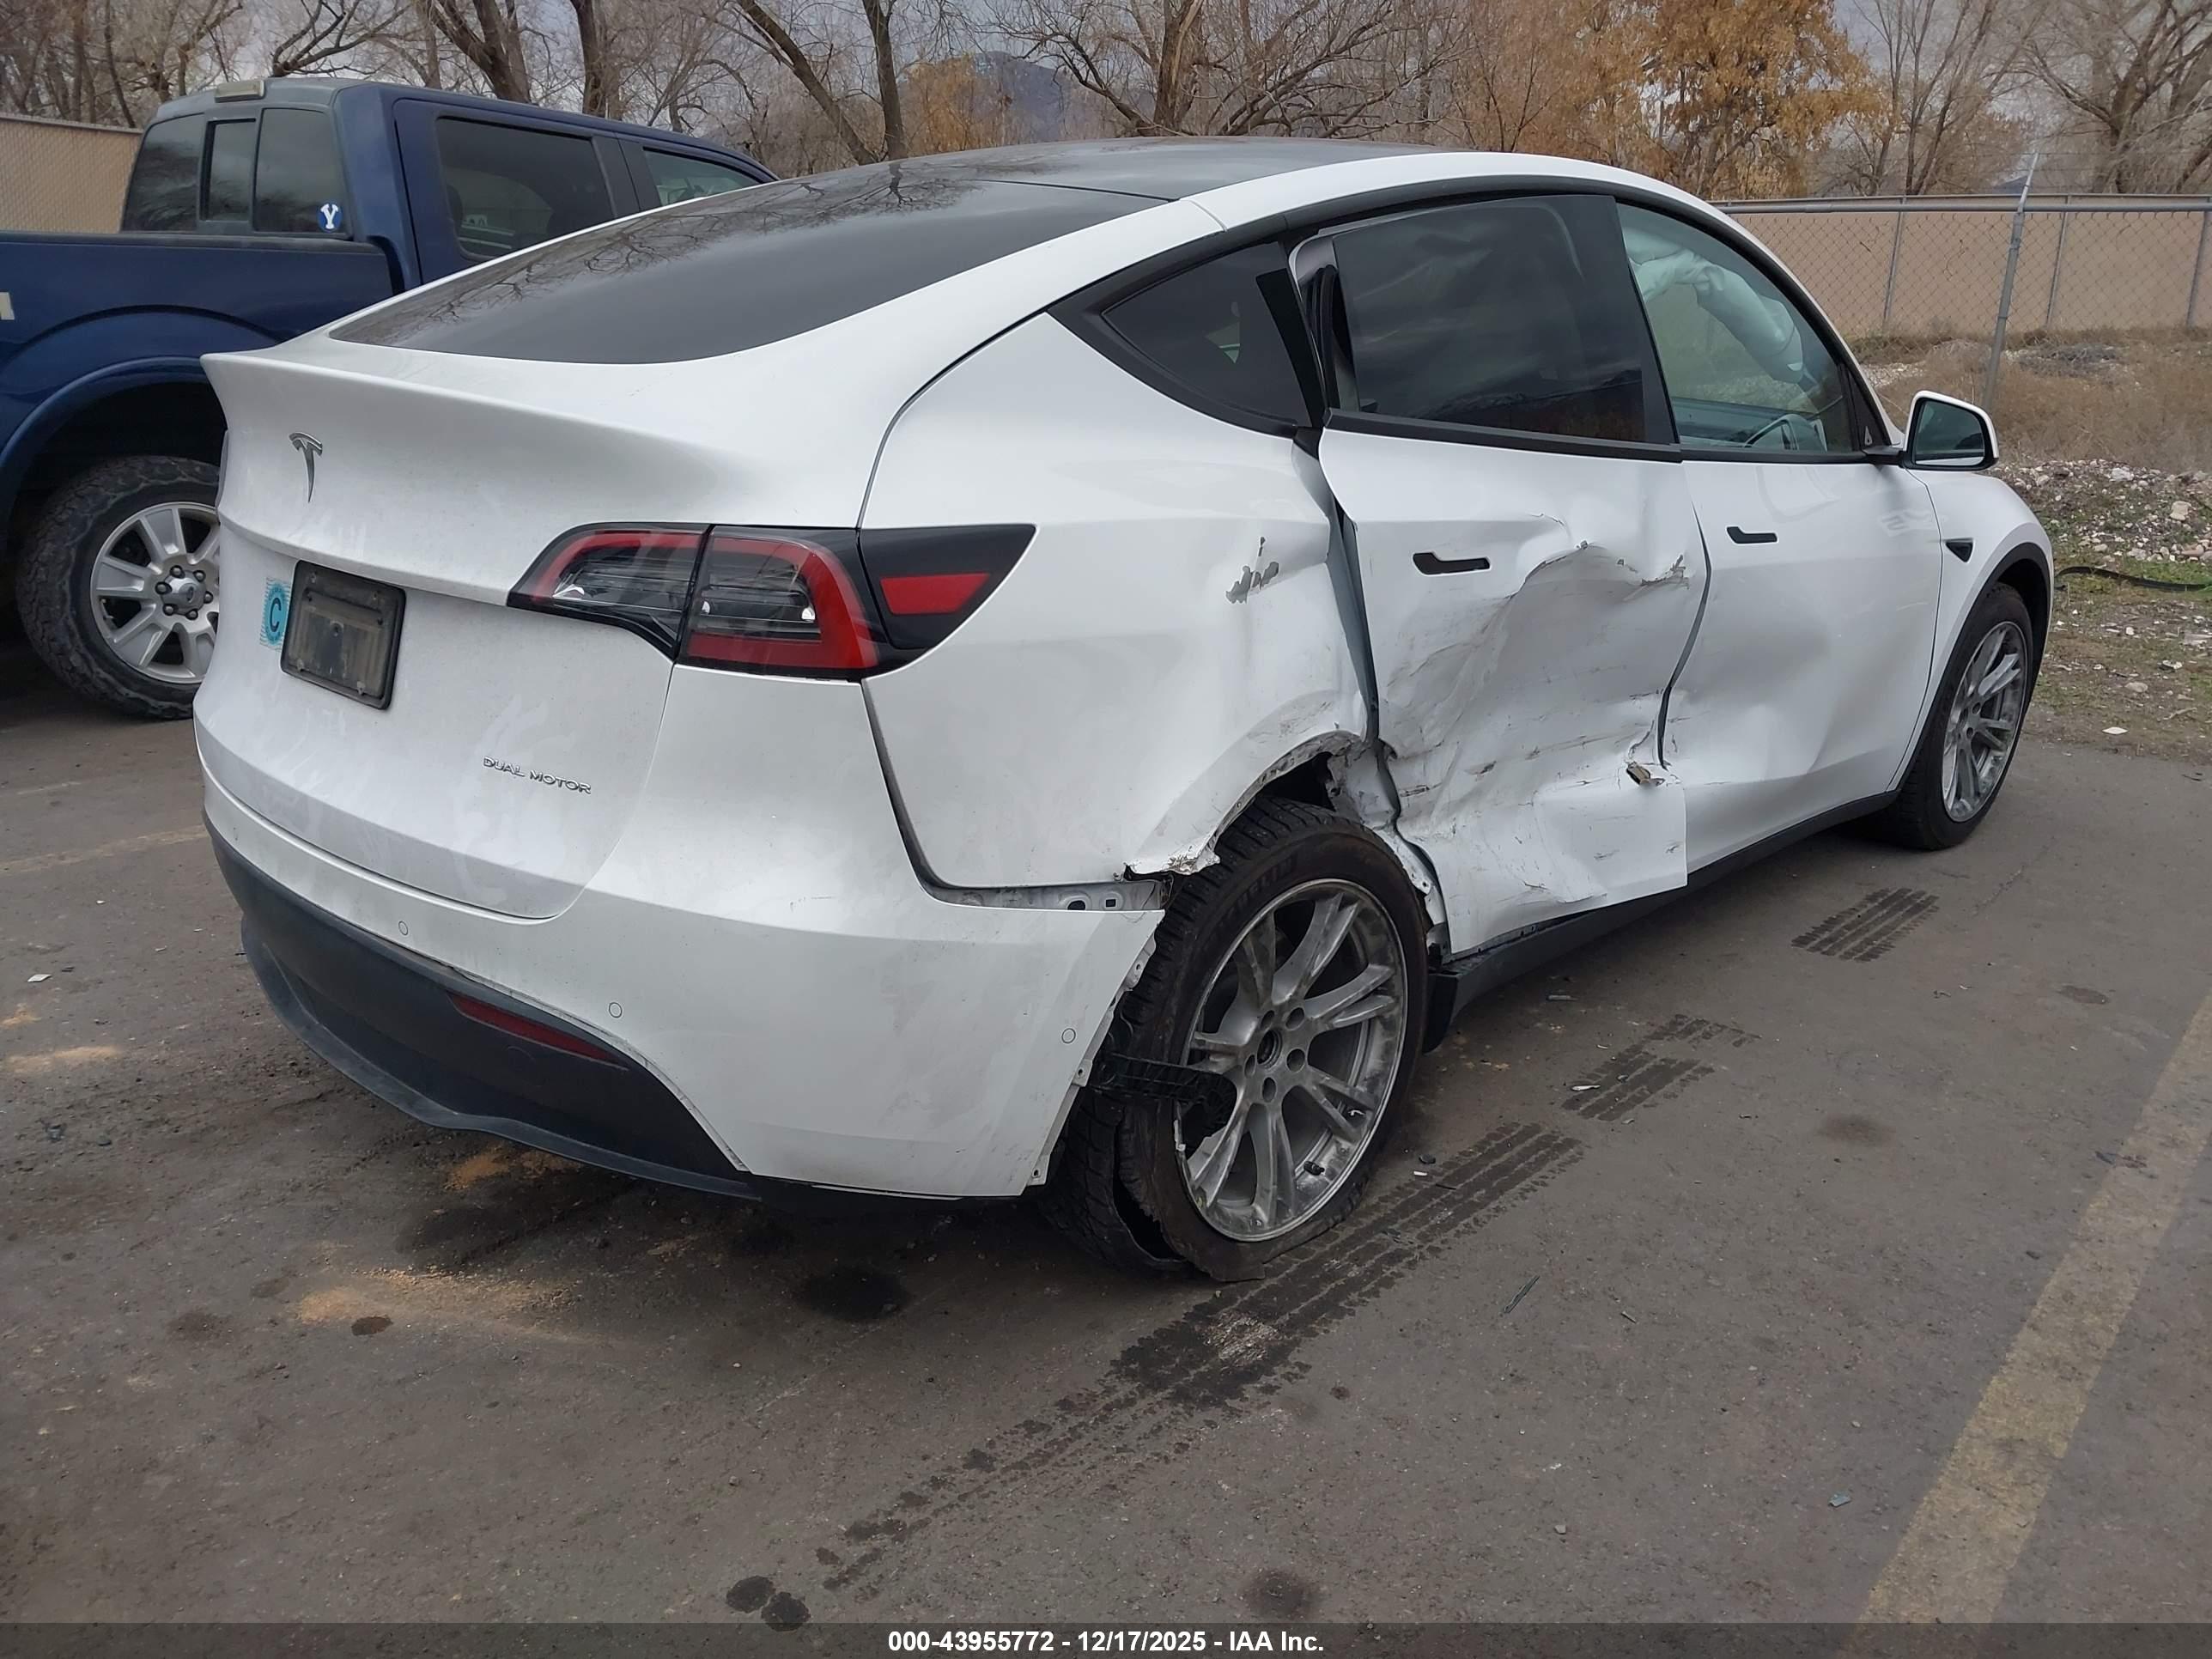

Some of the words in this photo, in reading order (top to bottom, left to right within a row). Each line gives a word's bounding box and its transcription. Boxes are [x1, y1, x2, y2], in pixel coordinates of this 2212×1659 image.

[320, 204, 339, 229] Y
[269, 597, 282, 633] C
[483, 756, 526, 778] DUAL
[529, 769, 592, 795] MOTOR
